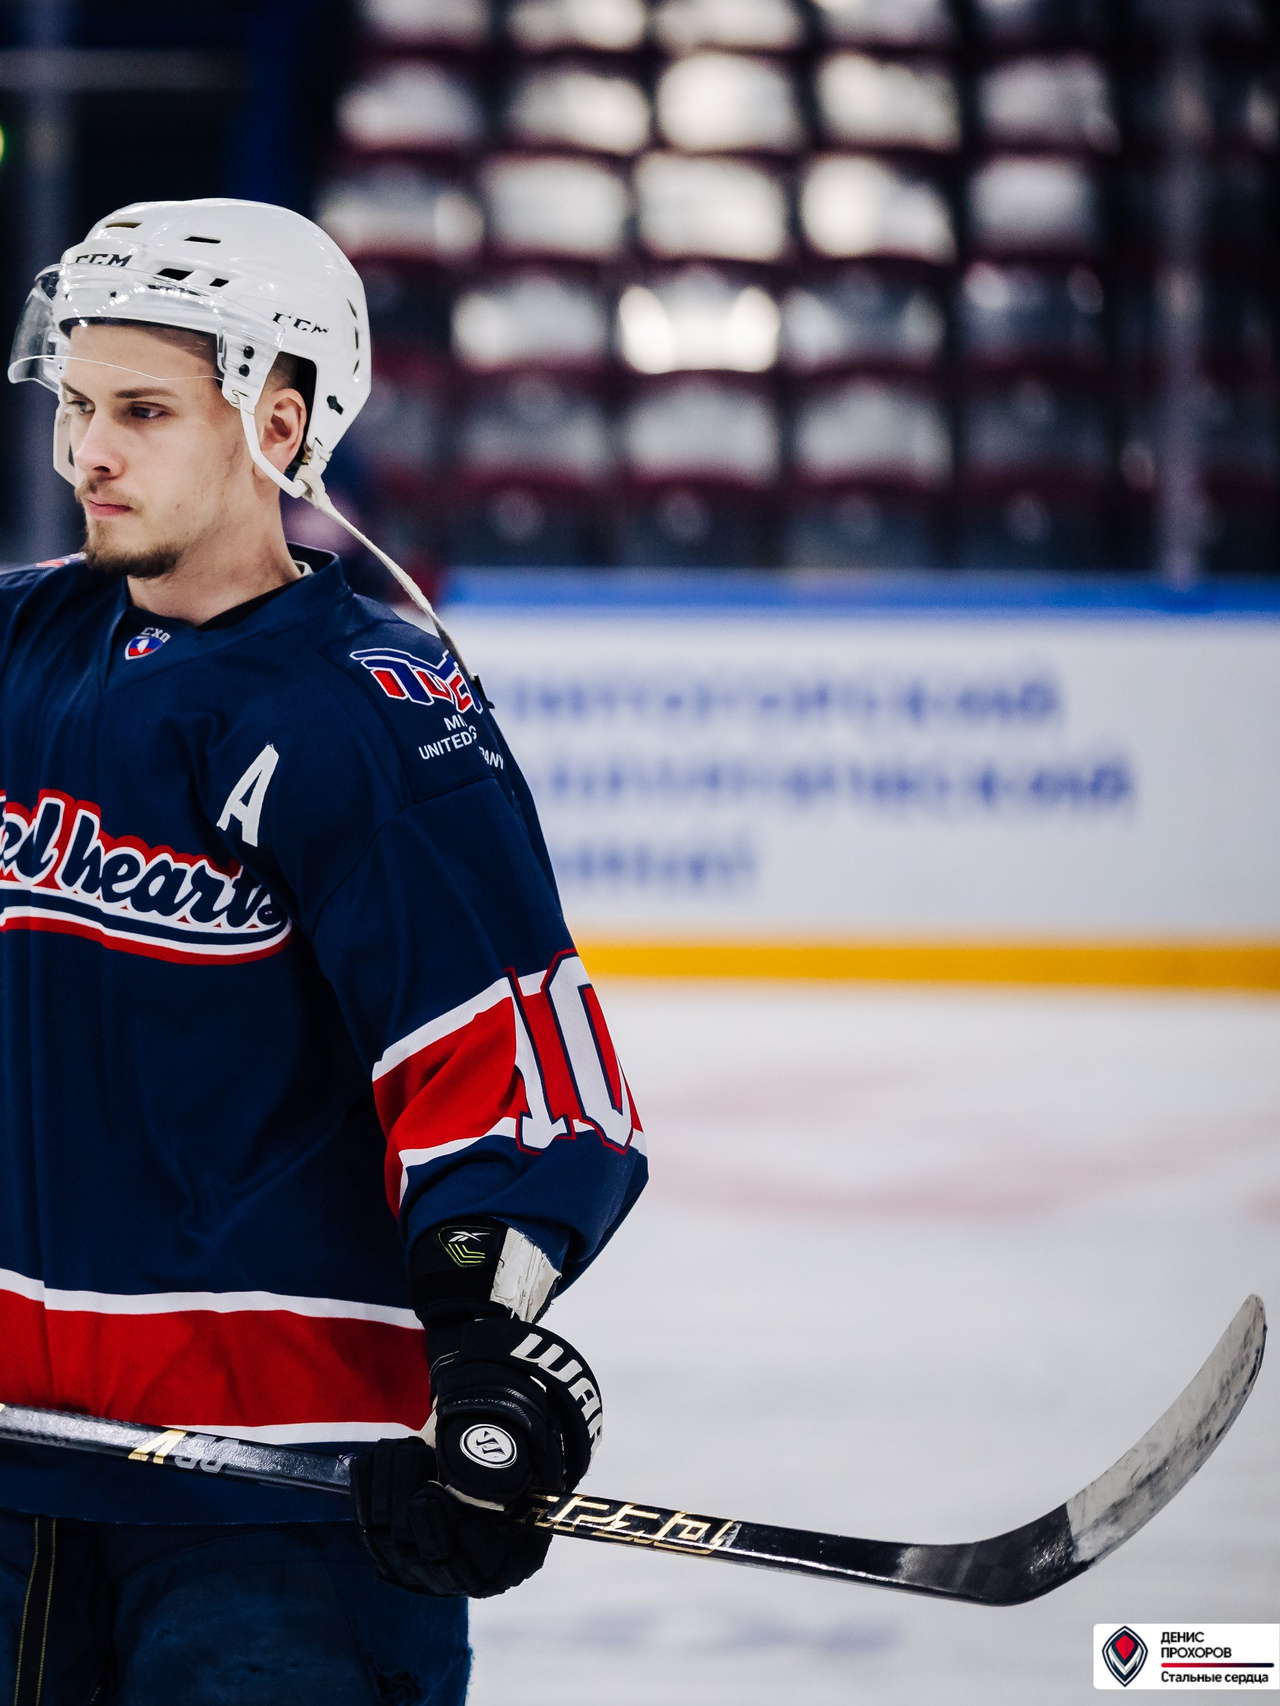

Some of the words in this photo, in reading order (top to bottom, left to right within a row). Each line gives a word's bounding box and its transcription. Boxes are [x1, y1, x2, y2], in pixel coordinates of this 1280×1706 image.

[216, 742, 280, 848] A
[418, 731, 473, 760] UNITED
[505, 948, 633, 1155] 10
